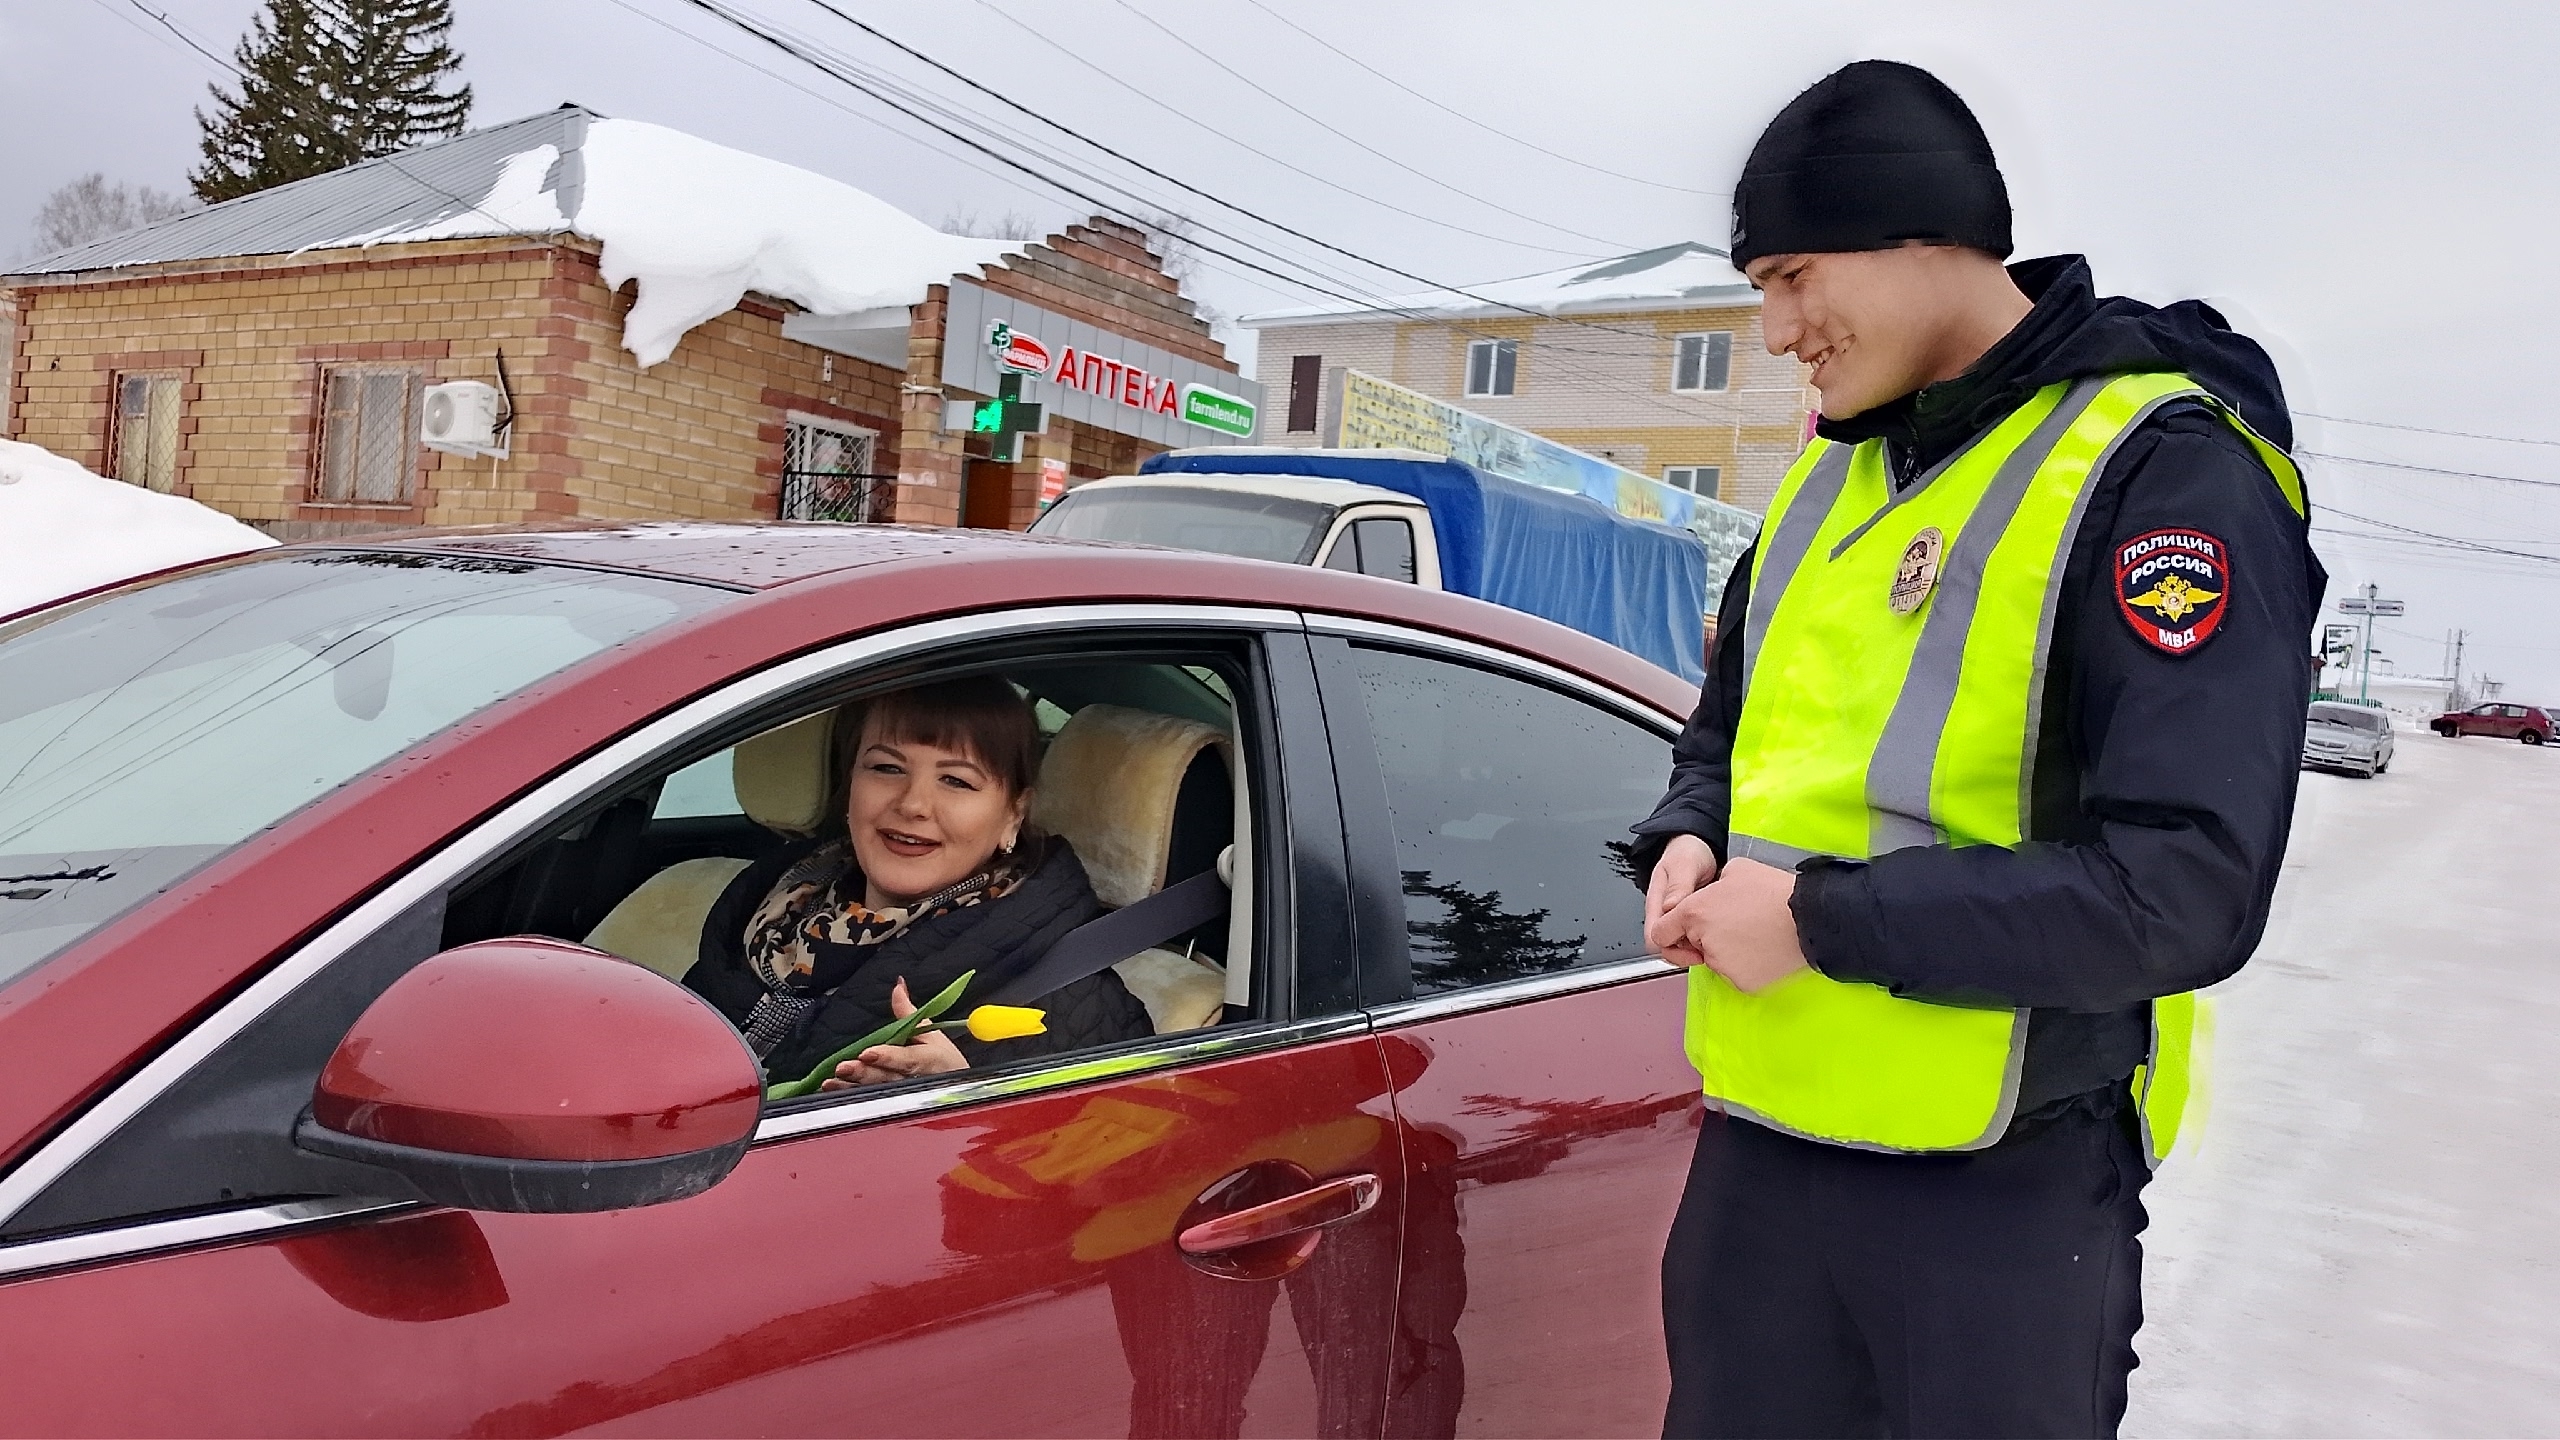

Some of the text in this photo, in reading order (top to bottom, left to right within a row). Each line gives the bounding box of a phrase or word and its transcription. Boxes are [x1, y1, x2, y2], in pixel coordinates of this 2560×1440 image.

[1055, 346, 1178, 419] АПТЕКА
[1190, 397, 1251, 429] farmlend.ru
[2123, 534, 2215, 566] ПОЛИЦИЯ
[2131, 554, 2213, 585] РОССИЯ
[2158, 627, 2197, 648] МВД
